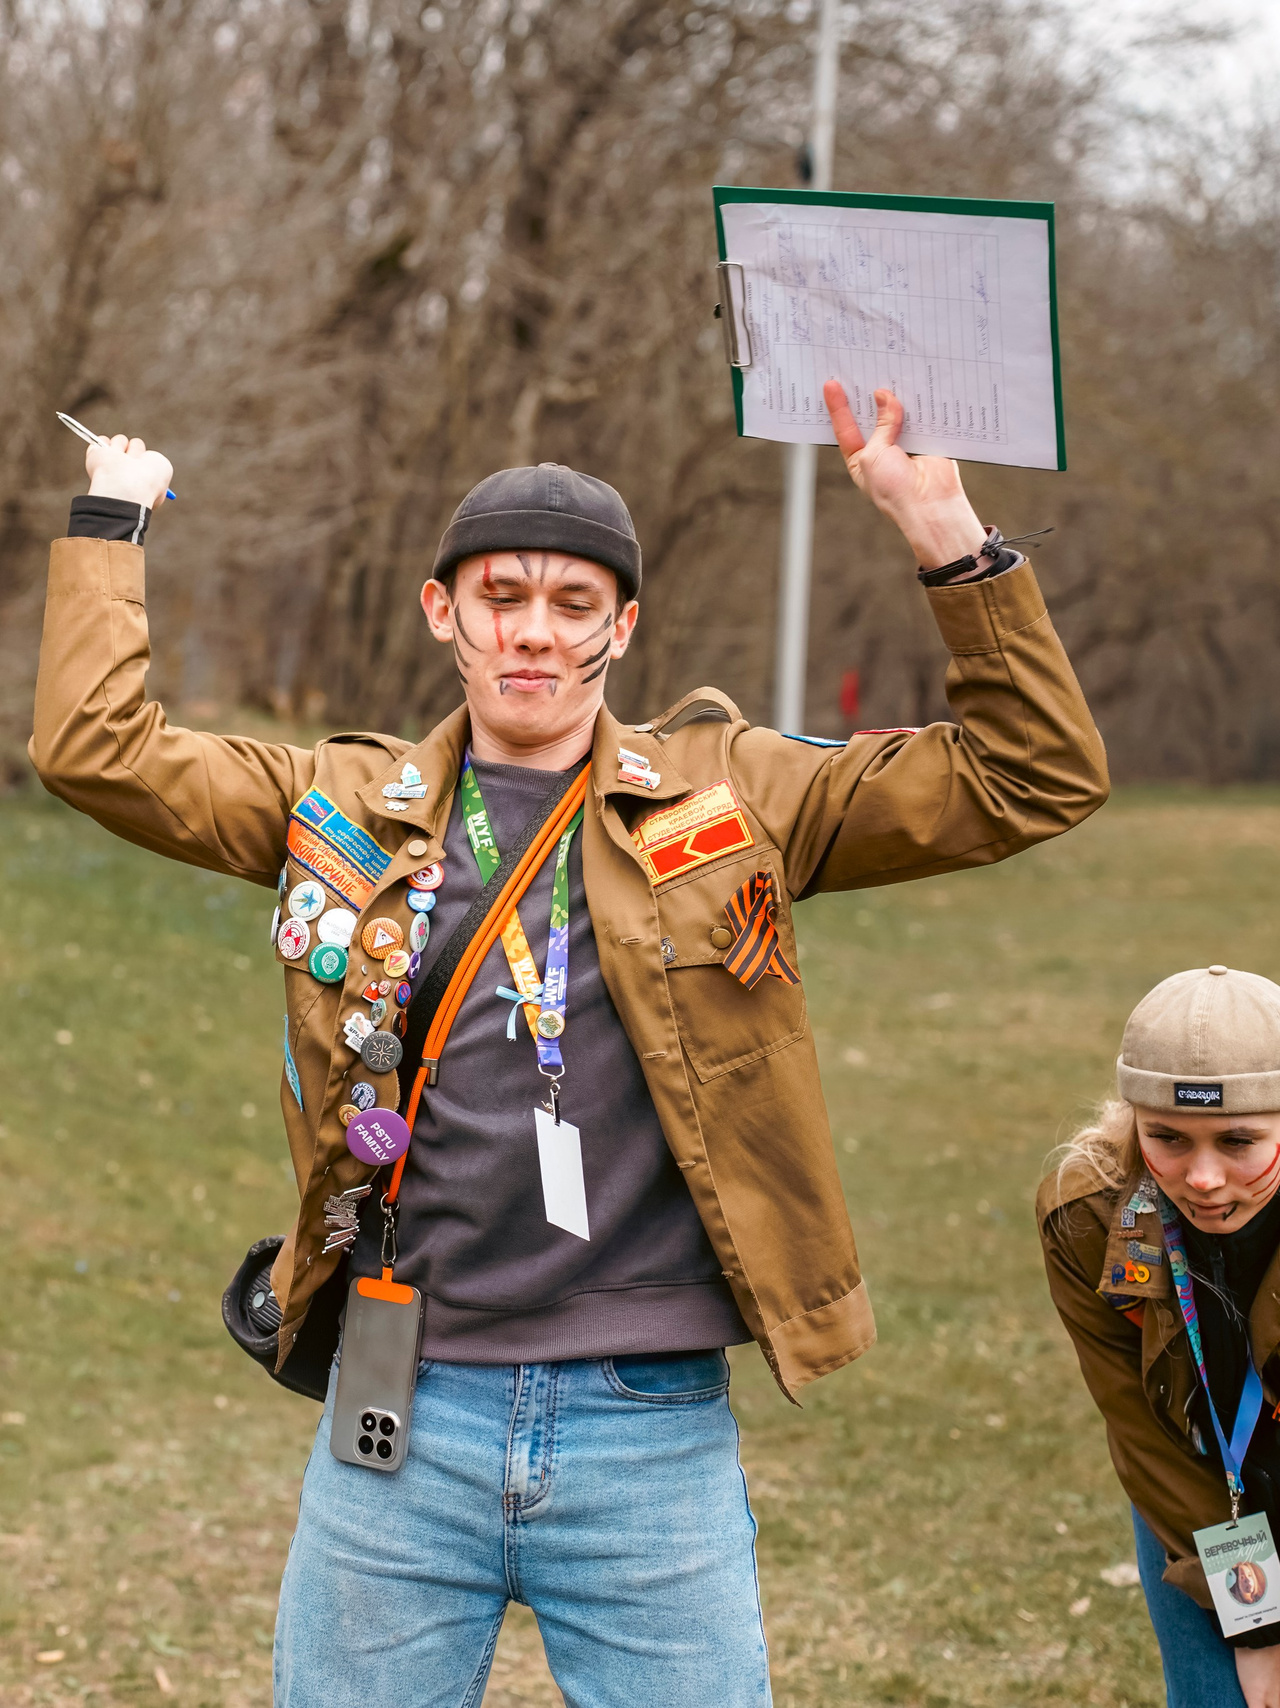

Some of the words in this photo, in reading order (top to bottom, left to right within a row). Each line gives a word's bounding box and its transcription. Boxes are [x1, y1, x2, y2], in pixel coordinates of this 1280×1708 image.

[647, 814, 706, 842] СТУДЕНЧЕСКИЙ
[707, 801, 733, 816] ОТРЯД
[649, 789, 718, 826] СТАВРОПОЛЬСКИЙ
[668, 805, 706, 826] КРАЕВОЙ
[472, 810, 493, 849] WYF
[543, 967, 560, 1006] WYF
[354, 1123, 390, 1161] FAMILY
[370, 1121, 397, 1150] PSTU
